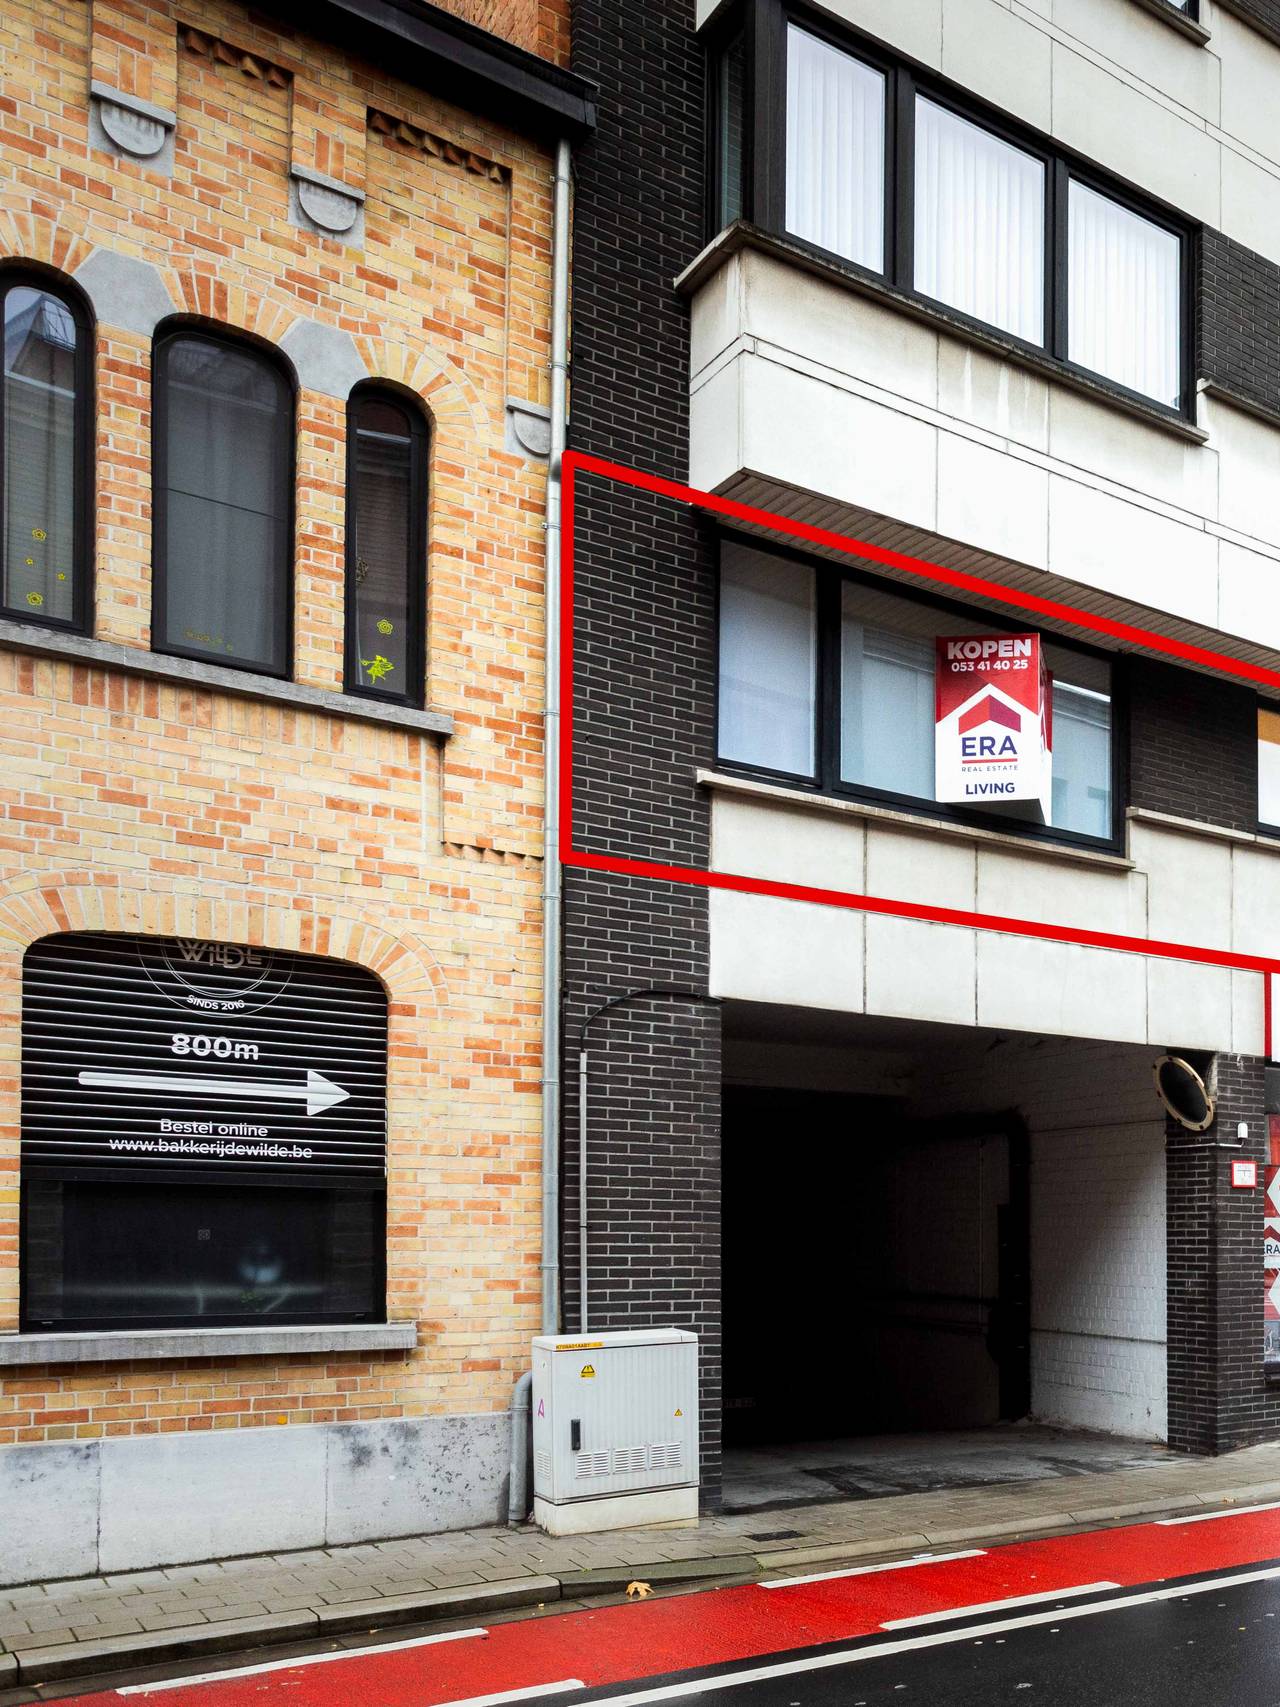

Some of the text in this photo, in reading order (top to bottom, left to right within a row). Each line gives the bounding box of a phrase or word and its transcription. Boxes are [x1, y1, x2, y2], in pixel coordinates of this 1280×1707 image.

[947, 639, 1031, 660] KOPEN
[951, 659, 1028, 672] 053 41 40 25
[961, 735, 1018, 757] ERA
[965, 782, 1015, 795] LIVING
[221, 1000, 245, 1010] 2016
[171, 1032, 259, 1060] 800m
[160, 1118, 268, 1137] Bestel online
[109, 1138, 313, 1159] www.bakkerijdewilde.be
